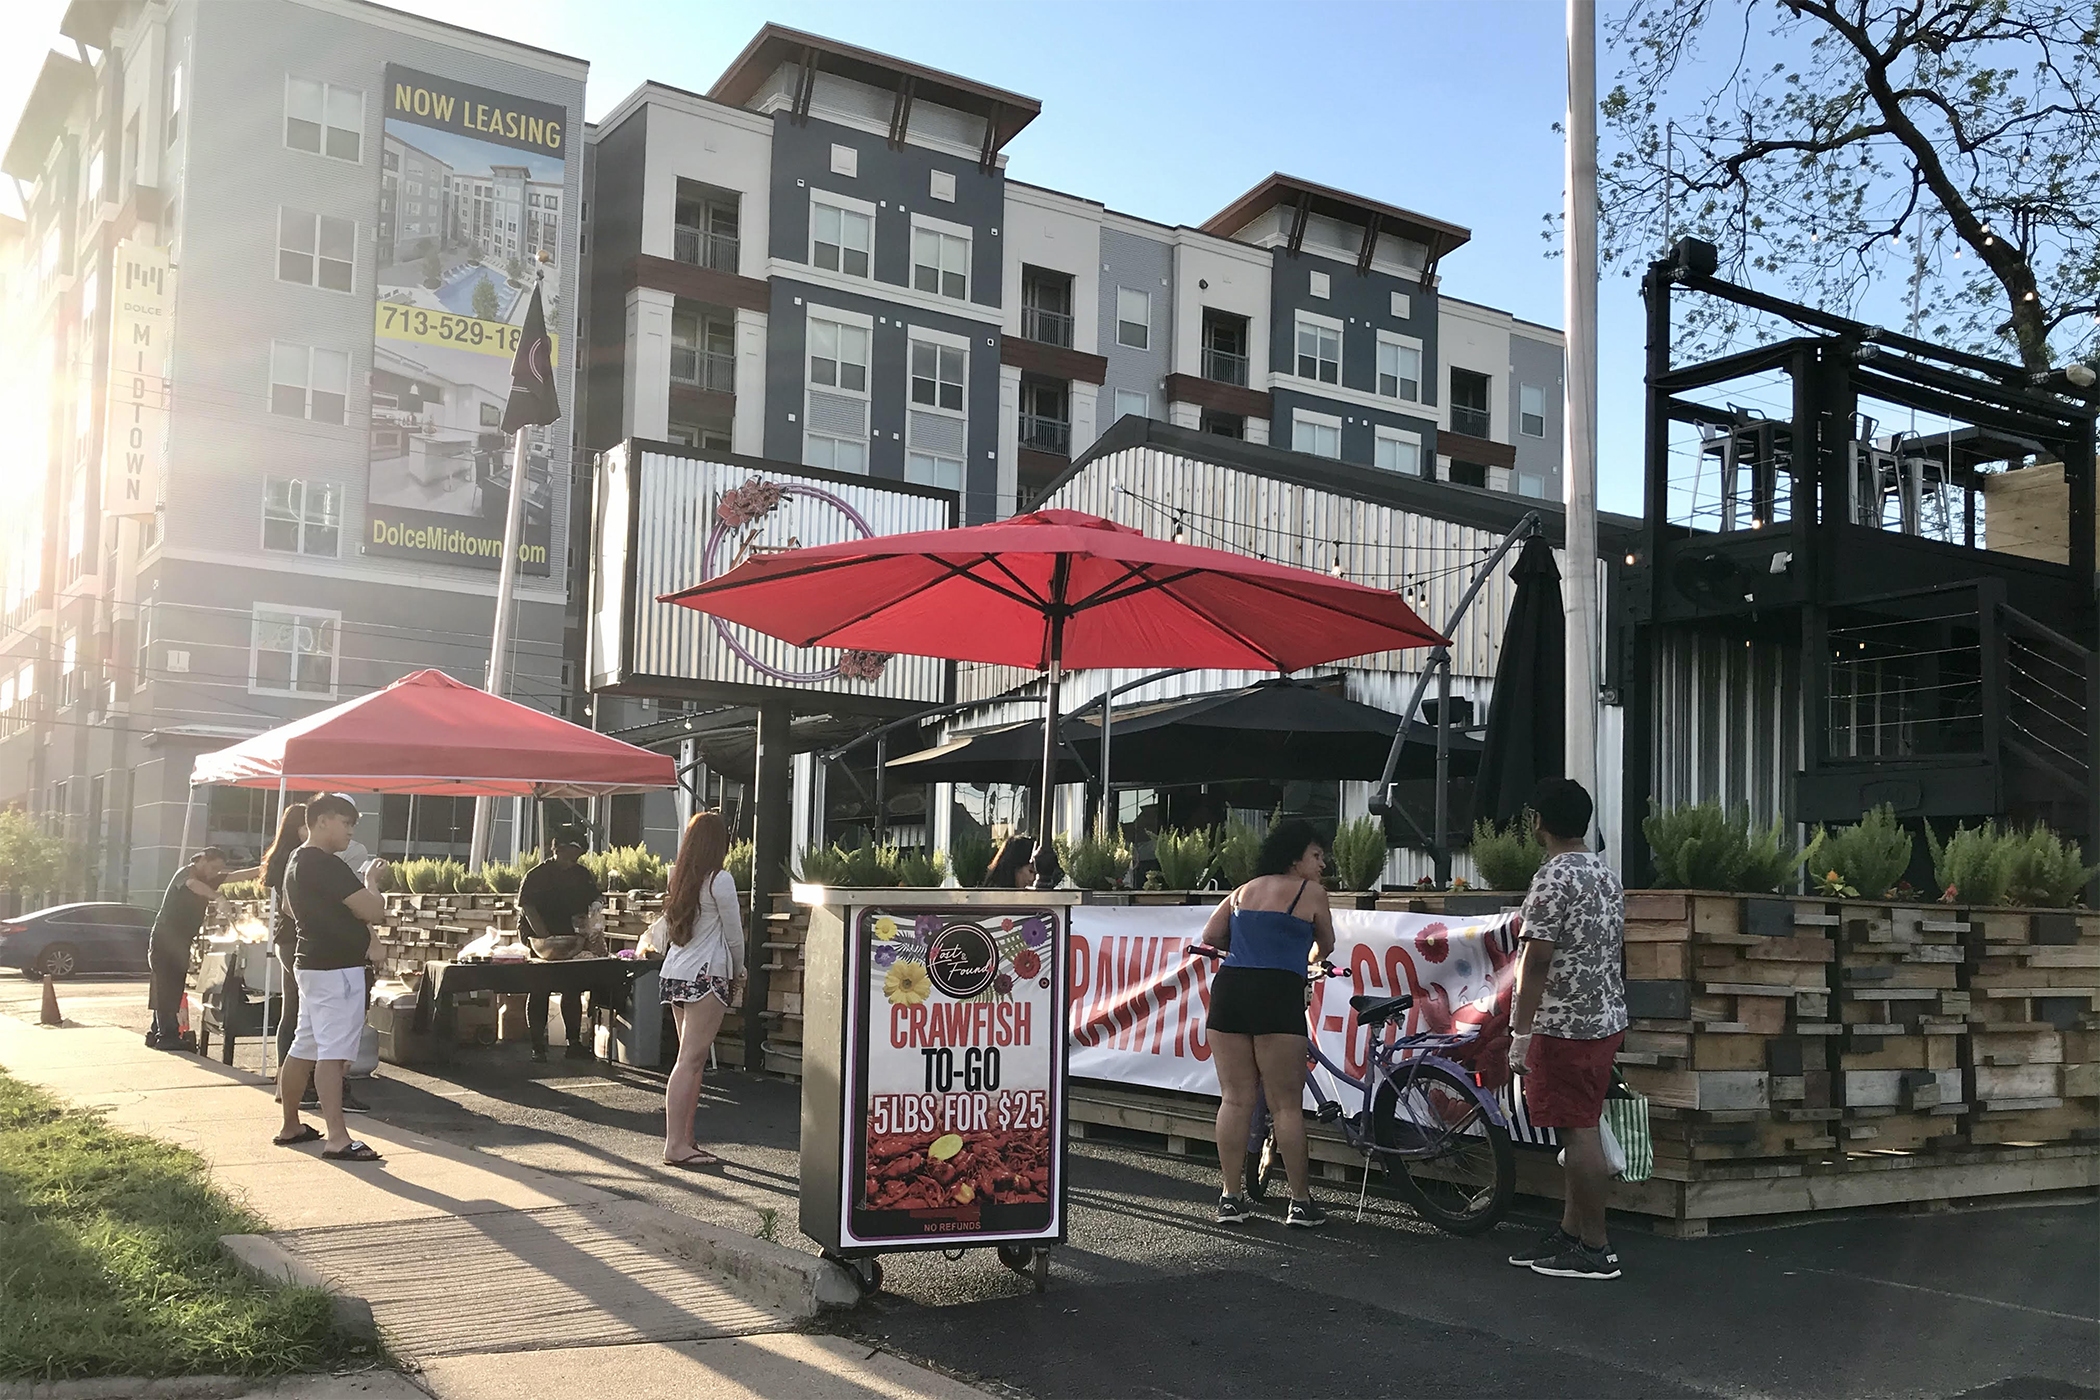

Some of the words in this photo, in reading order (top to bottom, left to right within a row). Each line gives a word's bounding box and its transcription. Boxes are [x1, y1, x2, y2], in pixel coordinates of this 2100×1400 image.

[395, 83, 455, 122] NOW
[463, 101, 561, 148] LEASING
[124, 302, 162, 316] DOLCE
[126, 323, 151, 500] MIDTOWN
[373, 520, 546, 563] DolceMidtownom
[947, 958, 993, 981] Found
[1070, 935, 1221, 1061] RAWFIS
[890, 1002, 1031, 1048] CRAWFISH
[921, 1047, 1000, 1093] TO-GO
[873, 1094, 936, 1135] 5LBS
[944, 1094, 988, 1132] FOR
[998, 1091, 1044, 1132] $25
[924, 1223, 937, 1232] NO
[939, 1221, 981, 1232] REFUNDS
